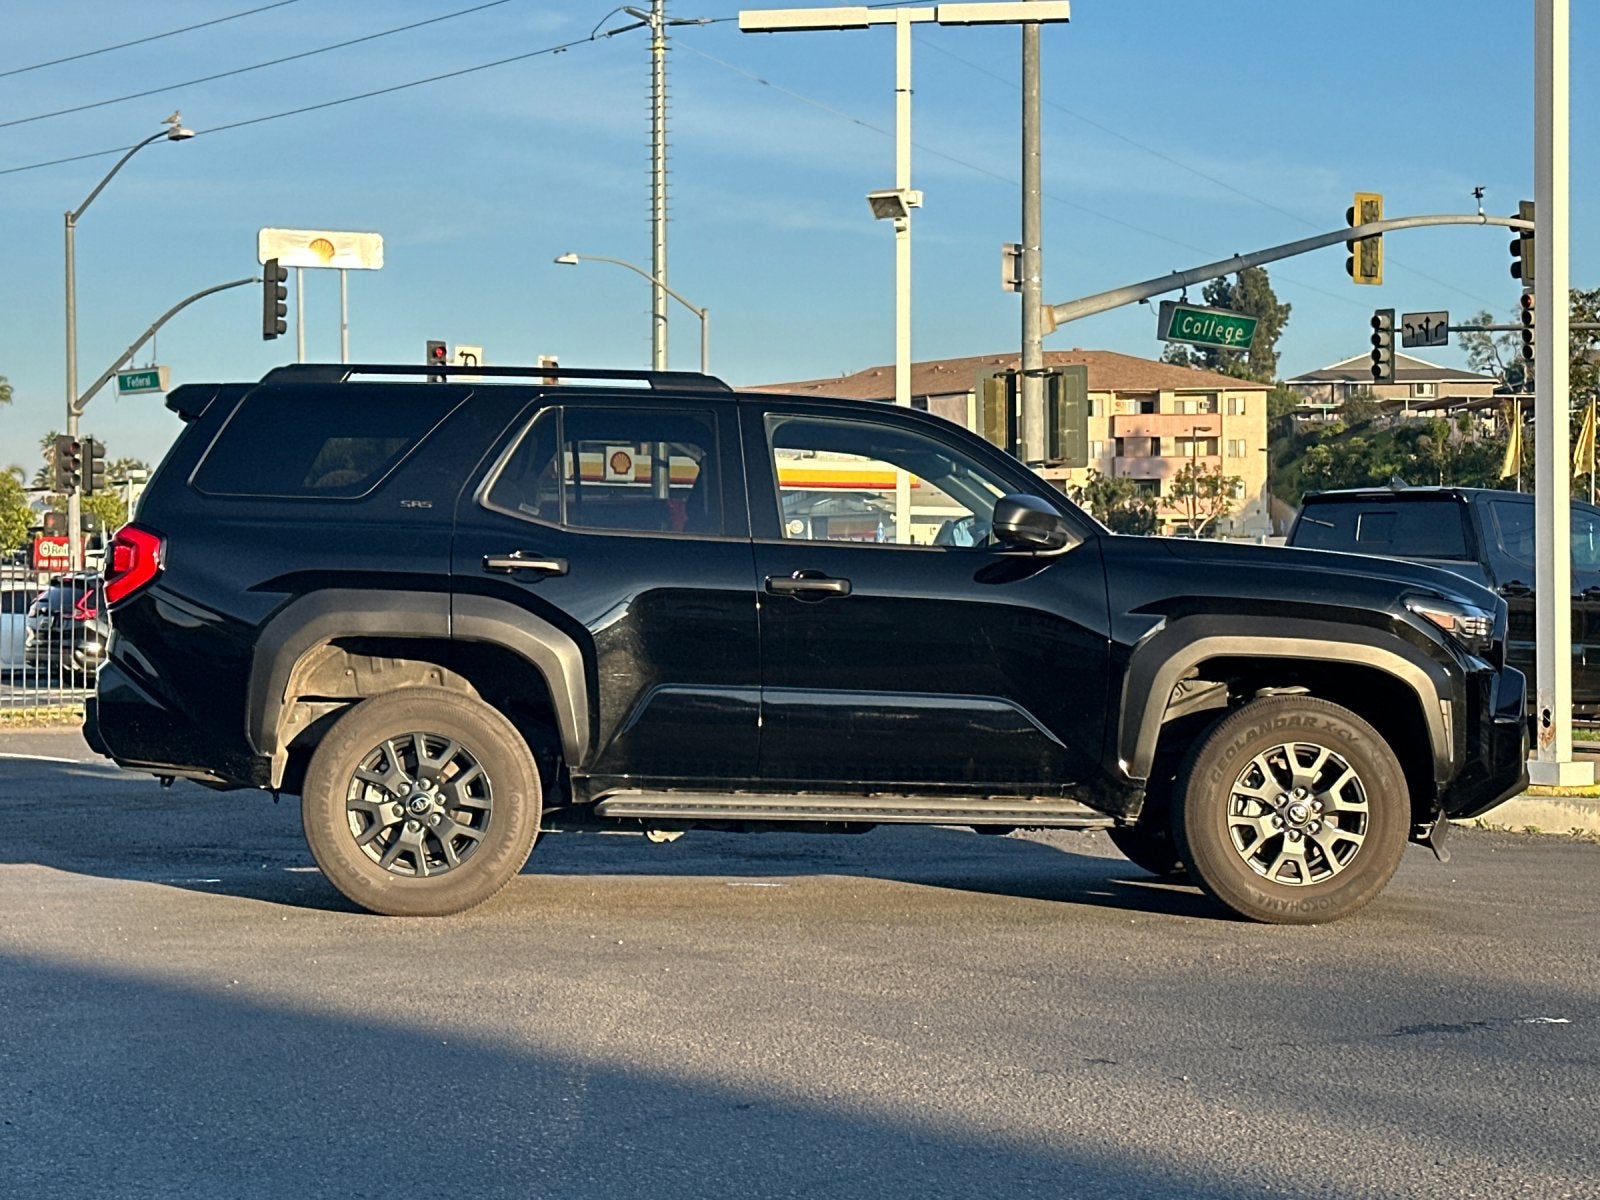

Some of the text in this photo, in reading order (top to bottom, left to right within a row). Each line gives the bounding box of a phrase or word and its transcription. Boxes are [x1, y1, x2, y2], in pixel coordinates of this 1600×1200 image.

[1183, 317, 1243, 344] College
[127, 376, 151, 388] Federal
[1211, 716, 1319, 784] GEOLANDAR
[1258, 893, 1338, 913] YOKOHAMA
